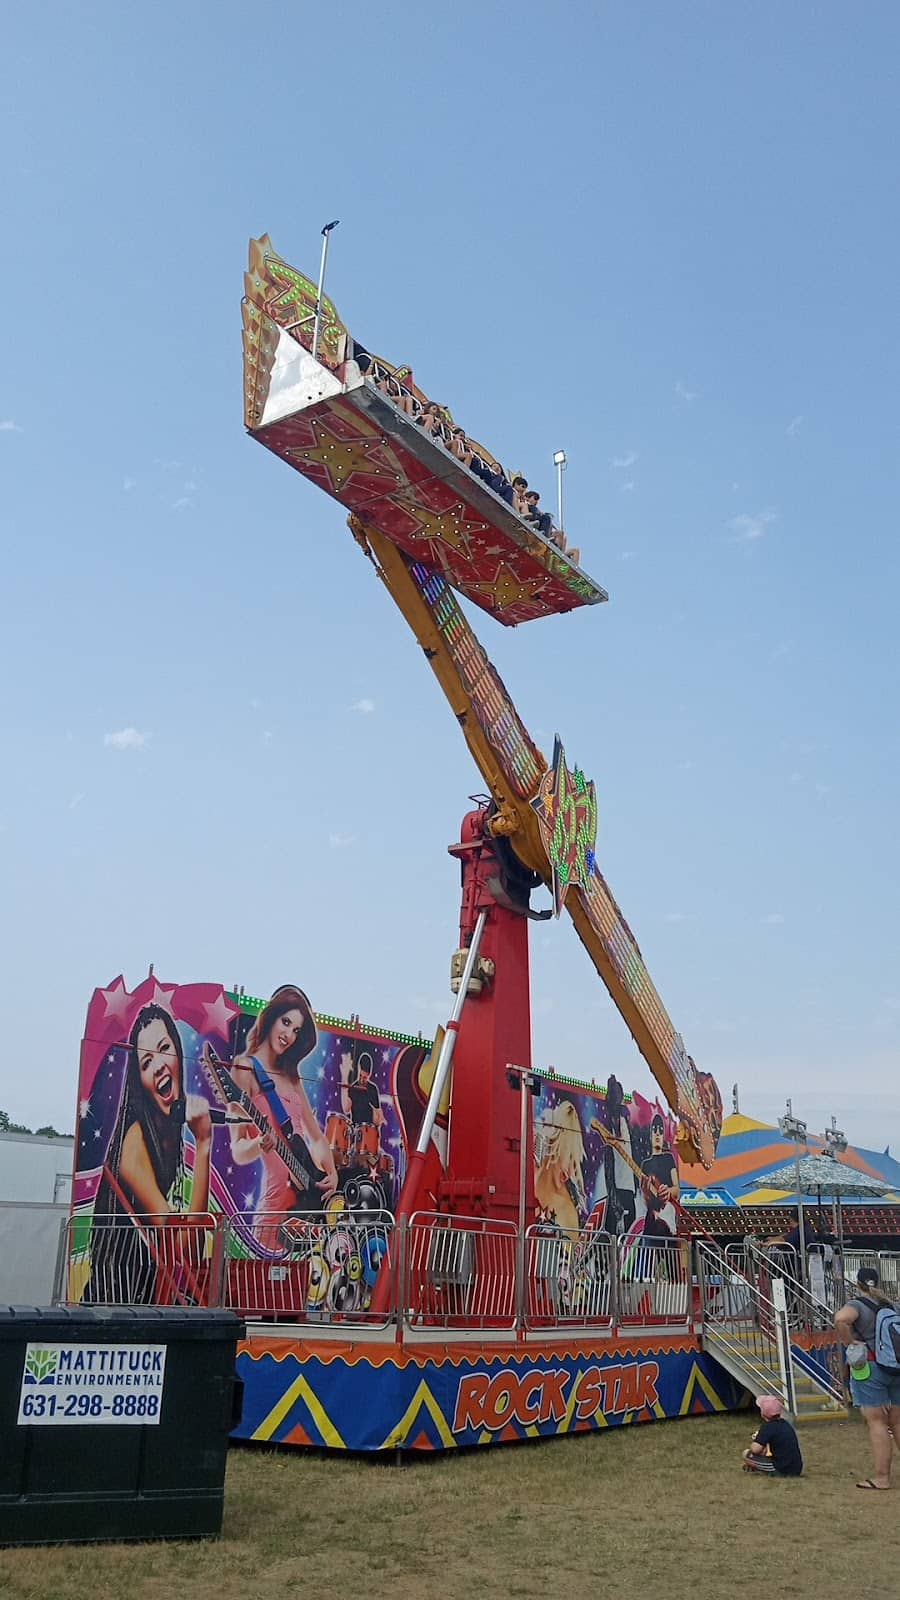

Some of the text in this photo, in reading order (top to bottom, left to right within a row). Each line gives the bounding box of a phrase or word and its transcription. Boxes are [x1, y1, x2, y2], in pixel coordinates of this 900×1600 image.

[59, 1350, 162, 1371] MATTITUCK
[56, 1374, 162, 1386] ENVIRONMENTAL
[22, 1394, 159, 1417] 631-298-8888
[452, 1361, 660, 1433] ROCK STAR
